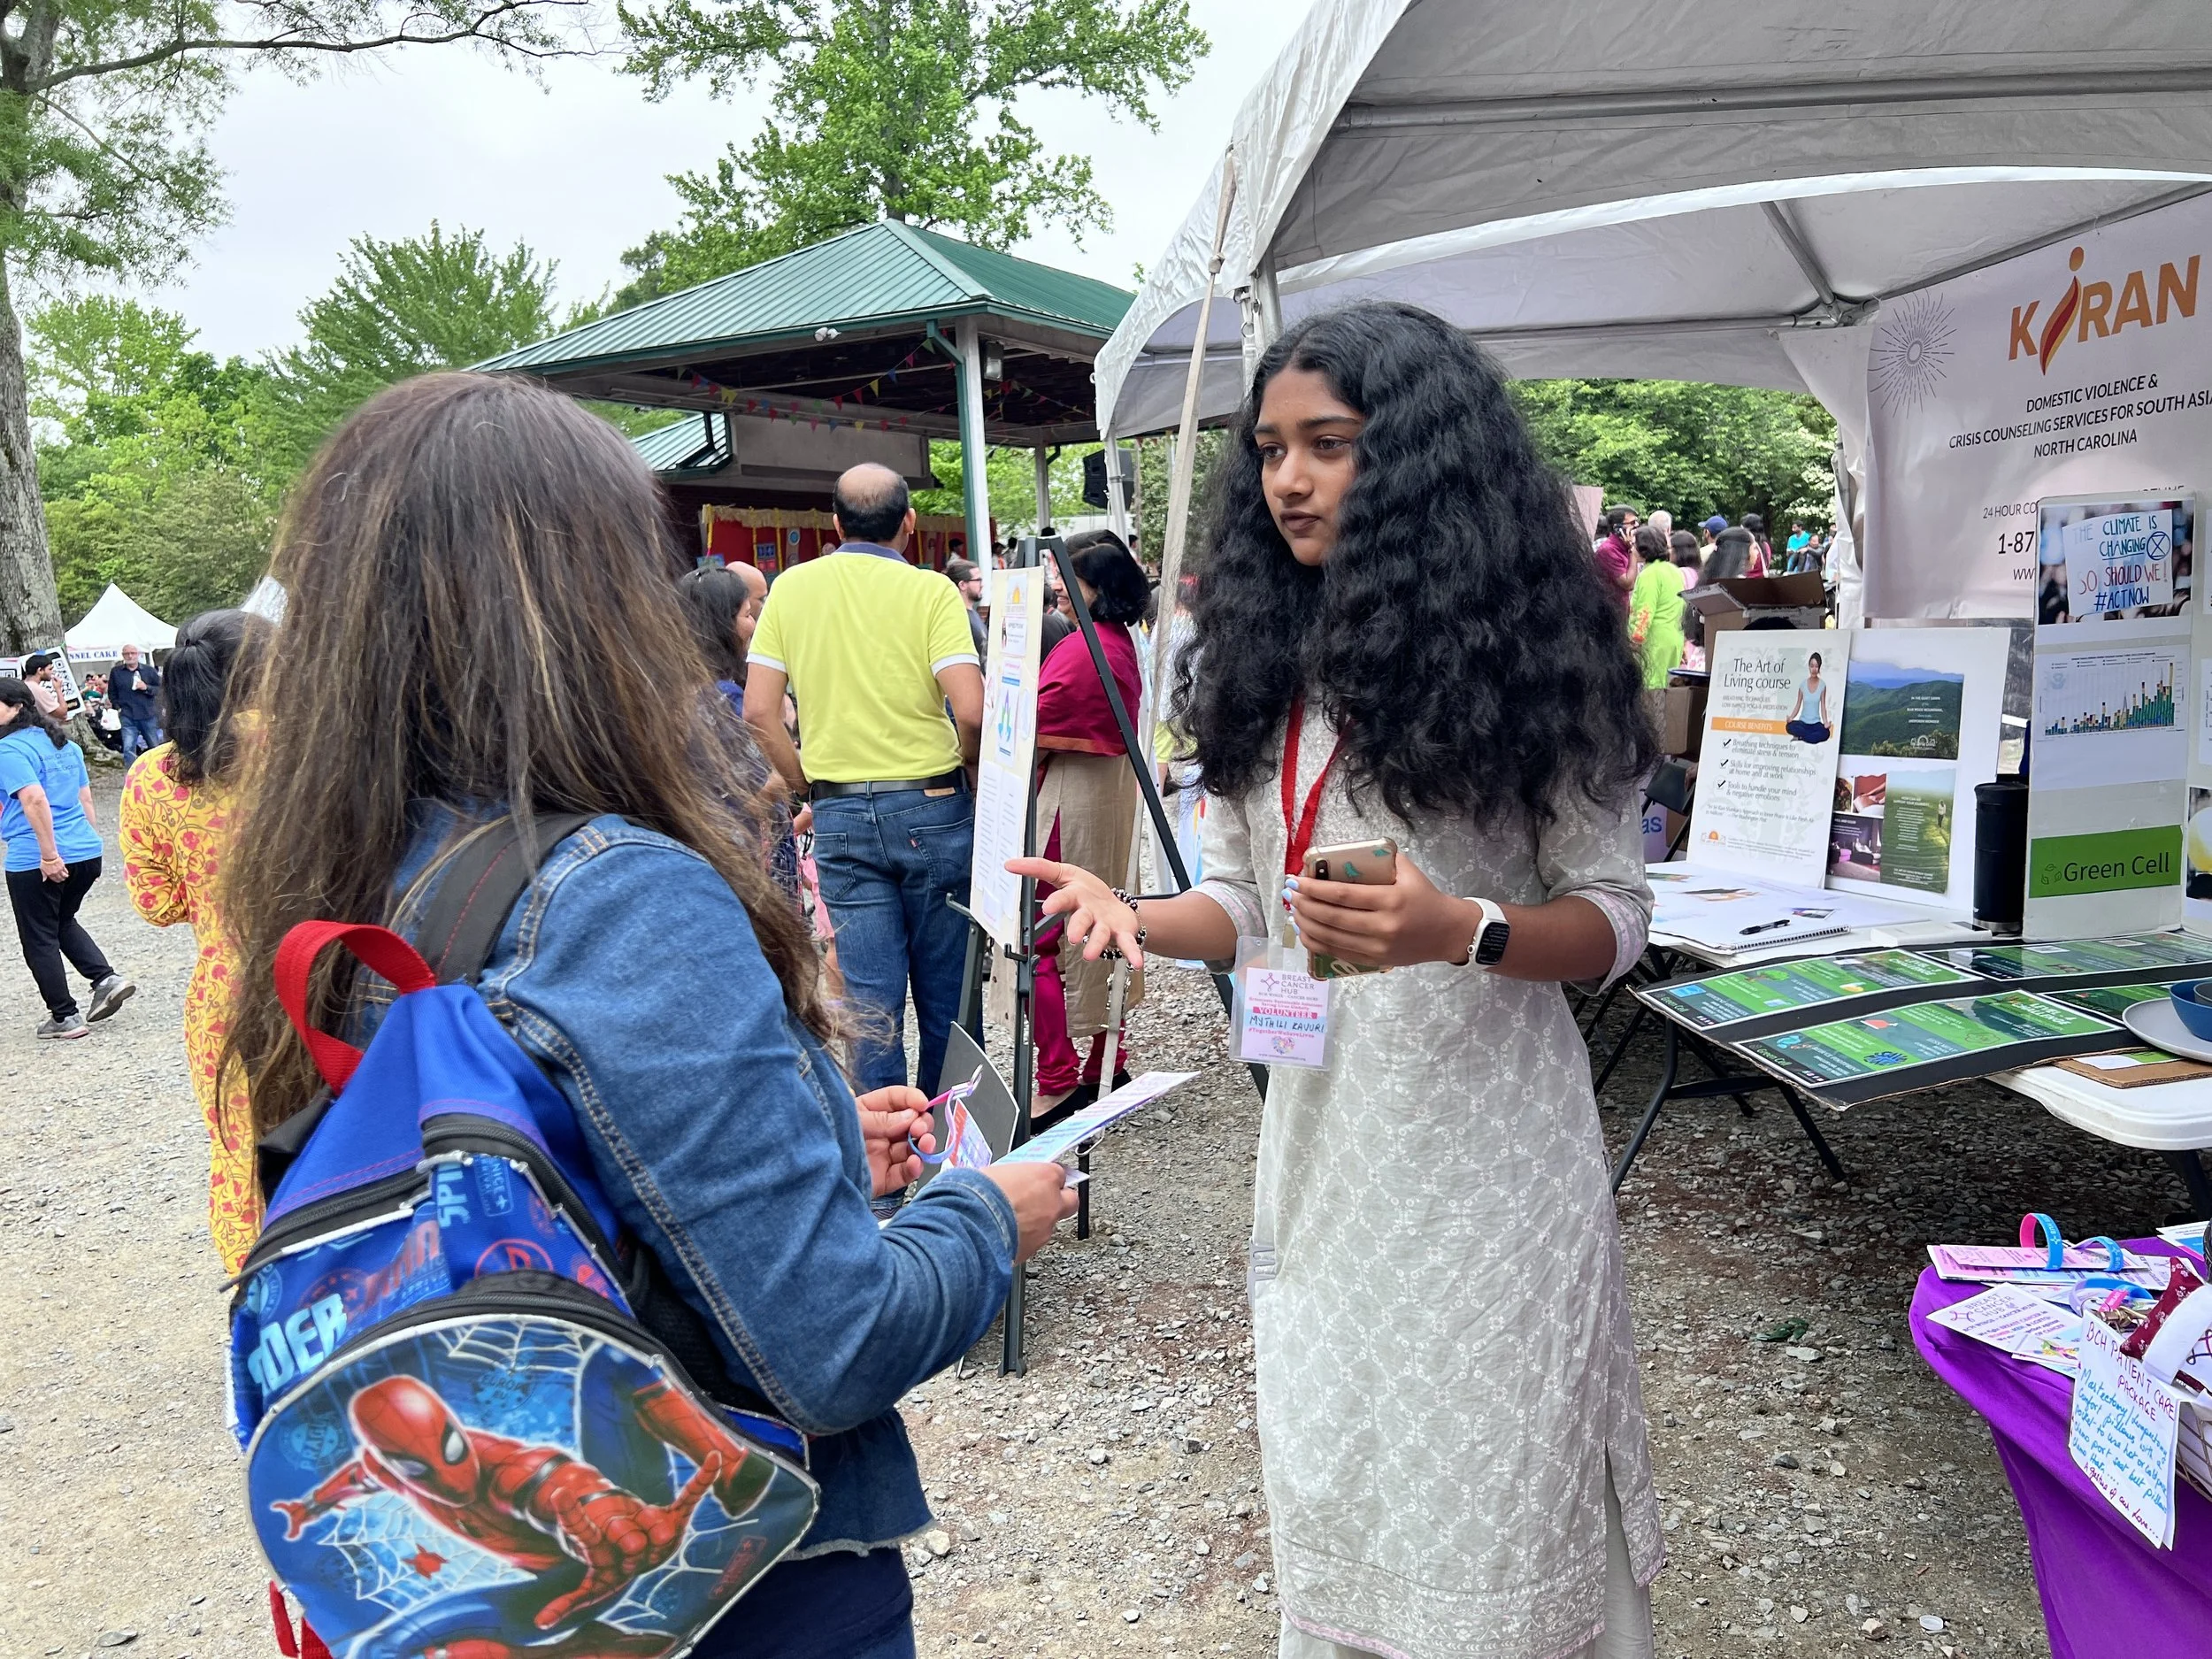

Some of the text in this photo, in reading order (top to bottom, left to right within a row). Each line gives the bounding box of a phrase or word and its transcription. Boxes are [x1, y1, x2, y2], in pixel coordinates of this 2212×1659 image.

[2027, 373, 2158, 413] DOMESTIC VIOLENCE &
[1949, 432, 1981, 449] CRISIS
[1984, 419, 2051, 442] COUNSELING
[2054, 409, 2108, 432] SERVICES
[2110, 403, 2133, 421] FOR
[2136, 395, 2185, 416] SOUTH
[2034, 428, 2137, 458] NORTH CAROLINA
[1983, 507, 1993, 519] 24
[1994, 504, 2021, 518] HOUR
[2102, 516, 2141, 535] CLIMATE
[2148, 515, 2157, 530] IS
[1998, 531, 2035, 555] 1-87
[2099, 537, 2147, 557] CHANGING
[2103, 564, 2142, 588] SHOULD
[2093, 587, 2149, 611] #ACTNOW
[1734, 657, 1786, 673] The Art of
[1724, 673, 1791, 693] Living course
[1747, 721, 1773, 731] BENEFITS
[1732, 740, 1757, 749] Breathing
[1758, 741, 1787, 752] techniques
[1732, 746, 1755, 755] eliminate
[1752, 763, 1779, 773] improving
[1781, 765, 1816, 777] relationships
[1752, 769, 1762, 779] and
[1732, 790, 1754, 799] negative
[1755, 793, 1780, 802] emotions
[1748, 782, 1767, 792] handle
[1782, 787, 1797, 796] mind
[2063, 852, 2170, 882] Green Cell
[1259, 1008, 1313, 1018] VOLUNTEER
[2011, 1002, 2072, 1025] CHALLENGE
[2030, 1002, 2061, 1015] LEVEL
[1249, 1016, 1325, 1033] MYTHILI KAVURI
[1756, 1048, 1778, 1063] Green
[1965, 1294, 2000, 1310] BREAST
[1974, 1295, 2015, 1313] CANCER
[1982, 1307, 2005, 1317] HUB
[2086, 1321, 2175, 1421] BCH PATIENT CARE
[2117, 1374, 2156, 1422] PACKAGE
[2091, 1440, 2112, 1456] port
[2097, 1425, 2105, 1436] to
[2108, 1433, 2121, 1448] use
[2124, 1443, 2138, 1459] hot
